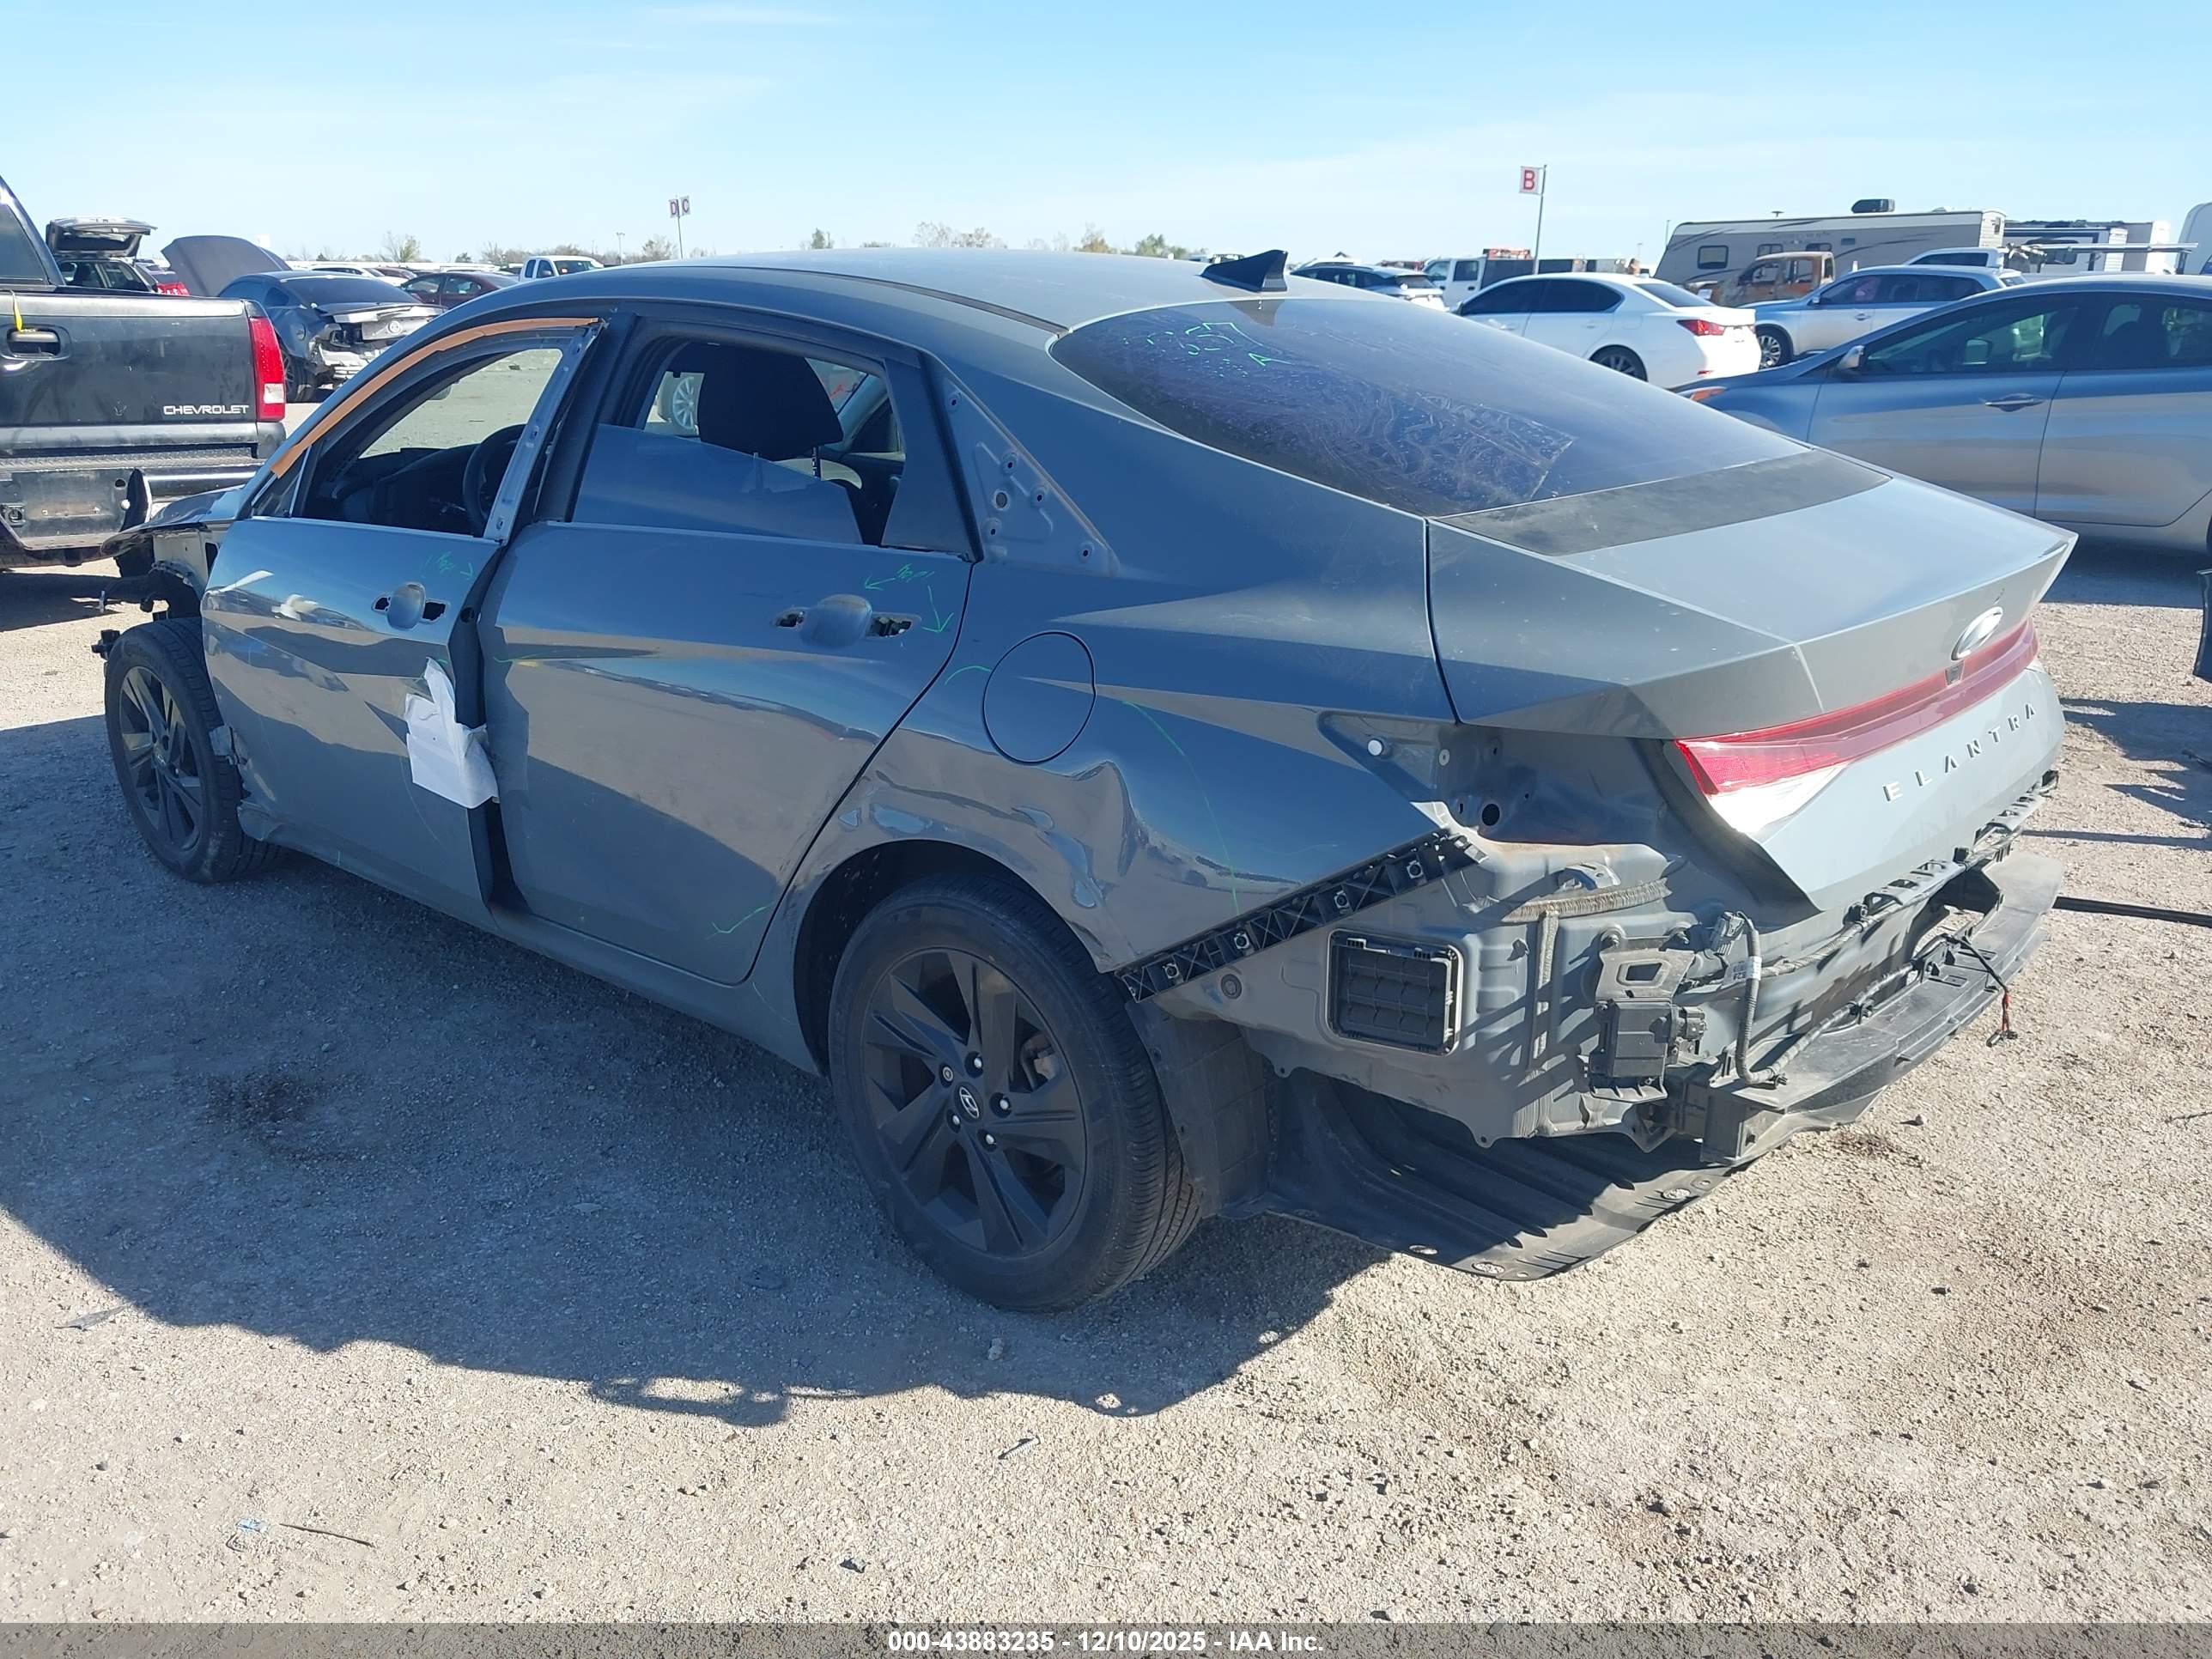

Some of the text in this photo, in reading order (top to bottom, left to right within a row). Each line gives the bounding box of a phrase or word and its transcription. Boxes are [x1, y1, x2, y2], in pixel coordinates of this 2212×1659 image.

[1522, 169, 1535, 191] B
[670, 201, 678, 216] D
[682, 198, 690, 213] C
[162, 404, 250, 416] CHEVROLET
[1882, 702, 2038, 803] ELANTRA
